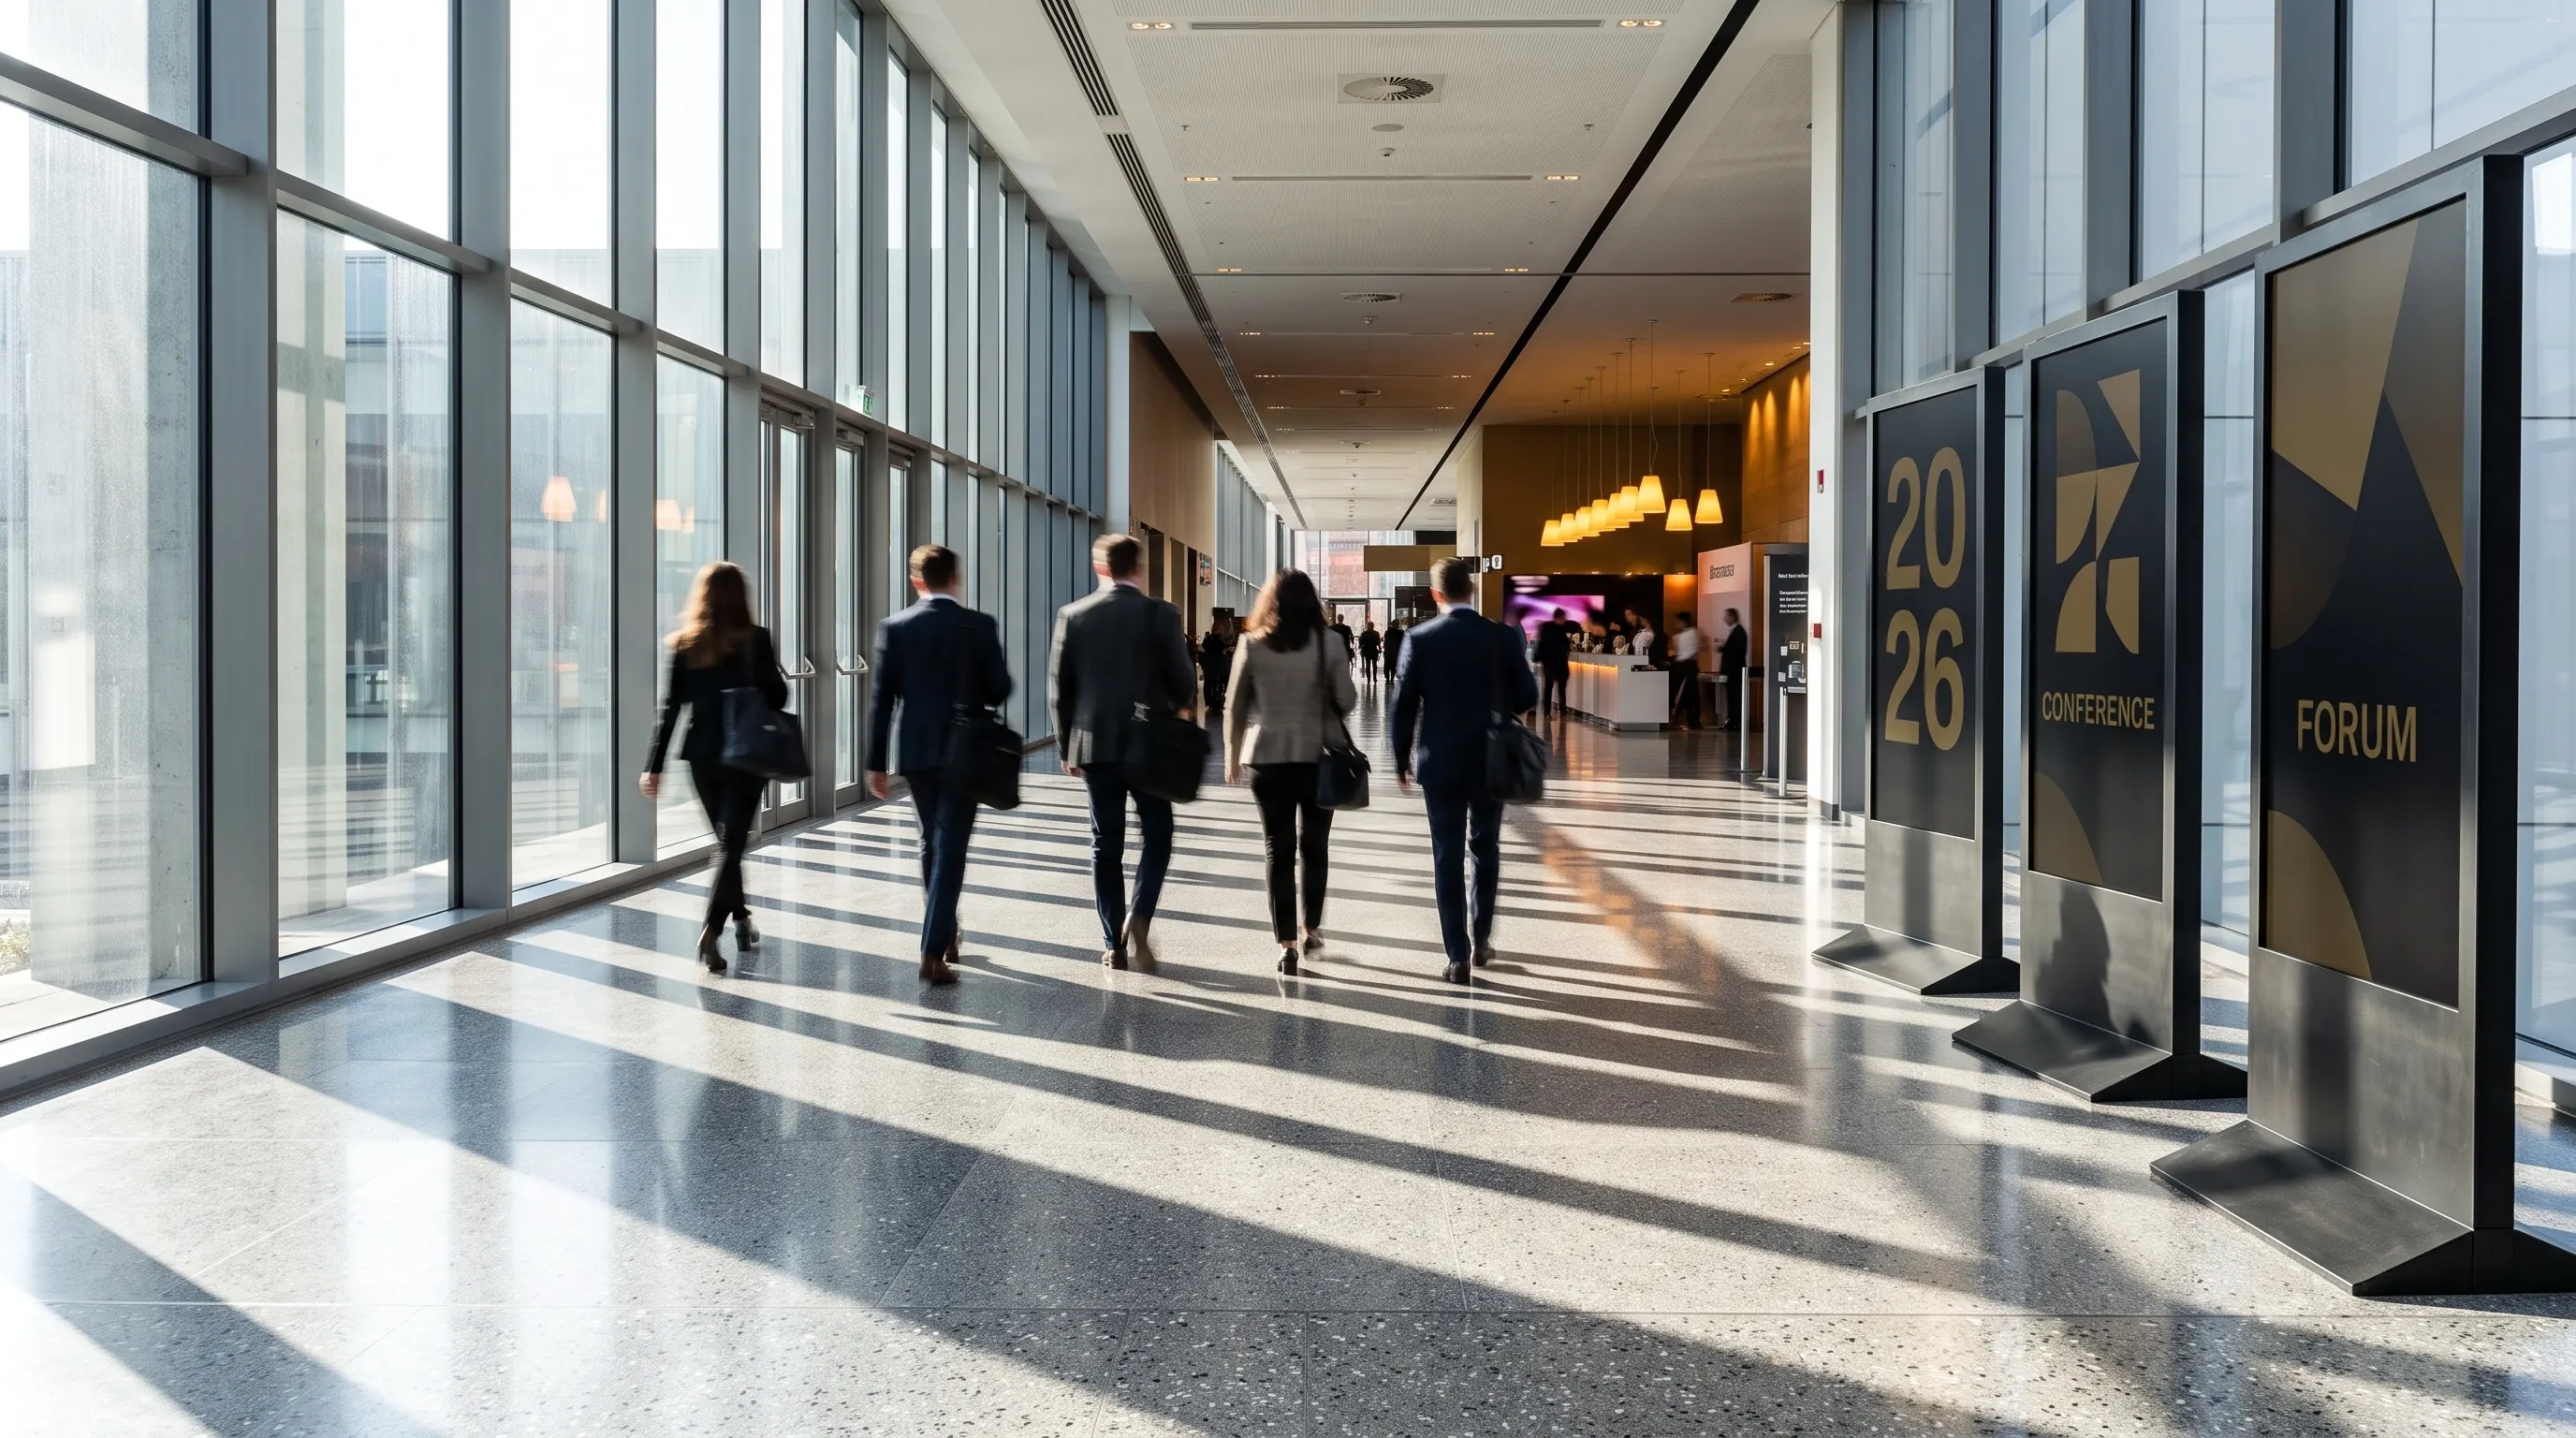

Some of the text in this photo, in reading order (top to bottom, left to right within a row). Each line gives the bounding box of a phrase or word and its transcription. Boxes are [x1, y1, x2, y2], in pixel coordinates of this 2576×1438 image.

[1886, 447, 1966, 590] 20
[1885, 608, 1965, 751] 26
[2042, 692, 2155, 731] CONFERENCE
[2297, 699, 2418, 762] FORUM
